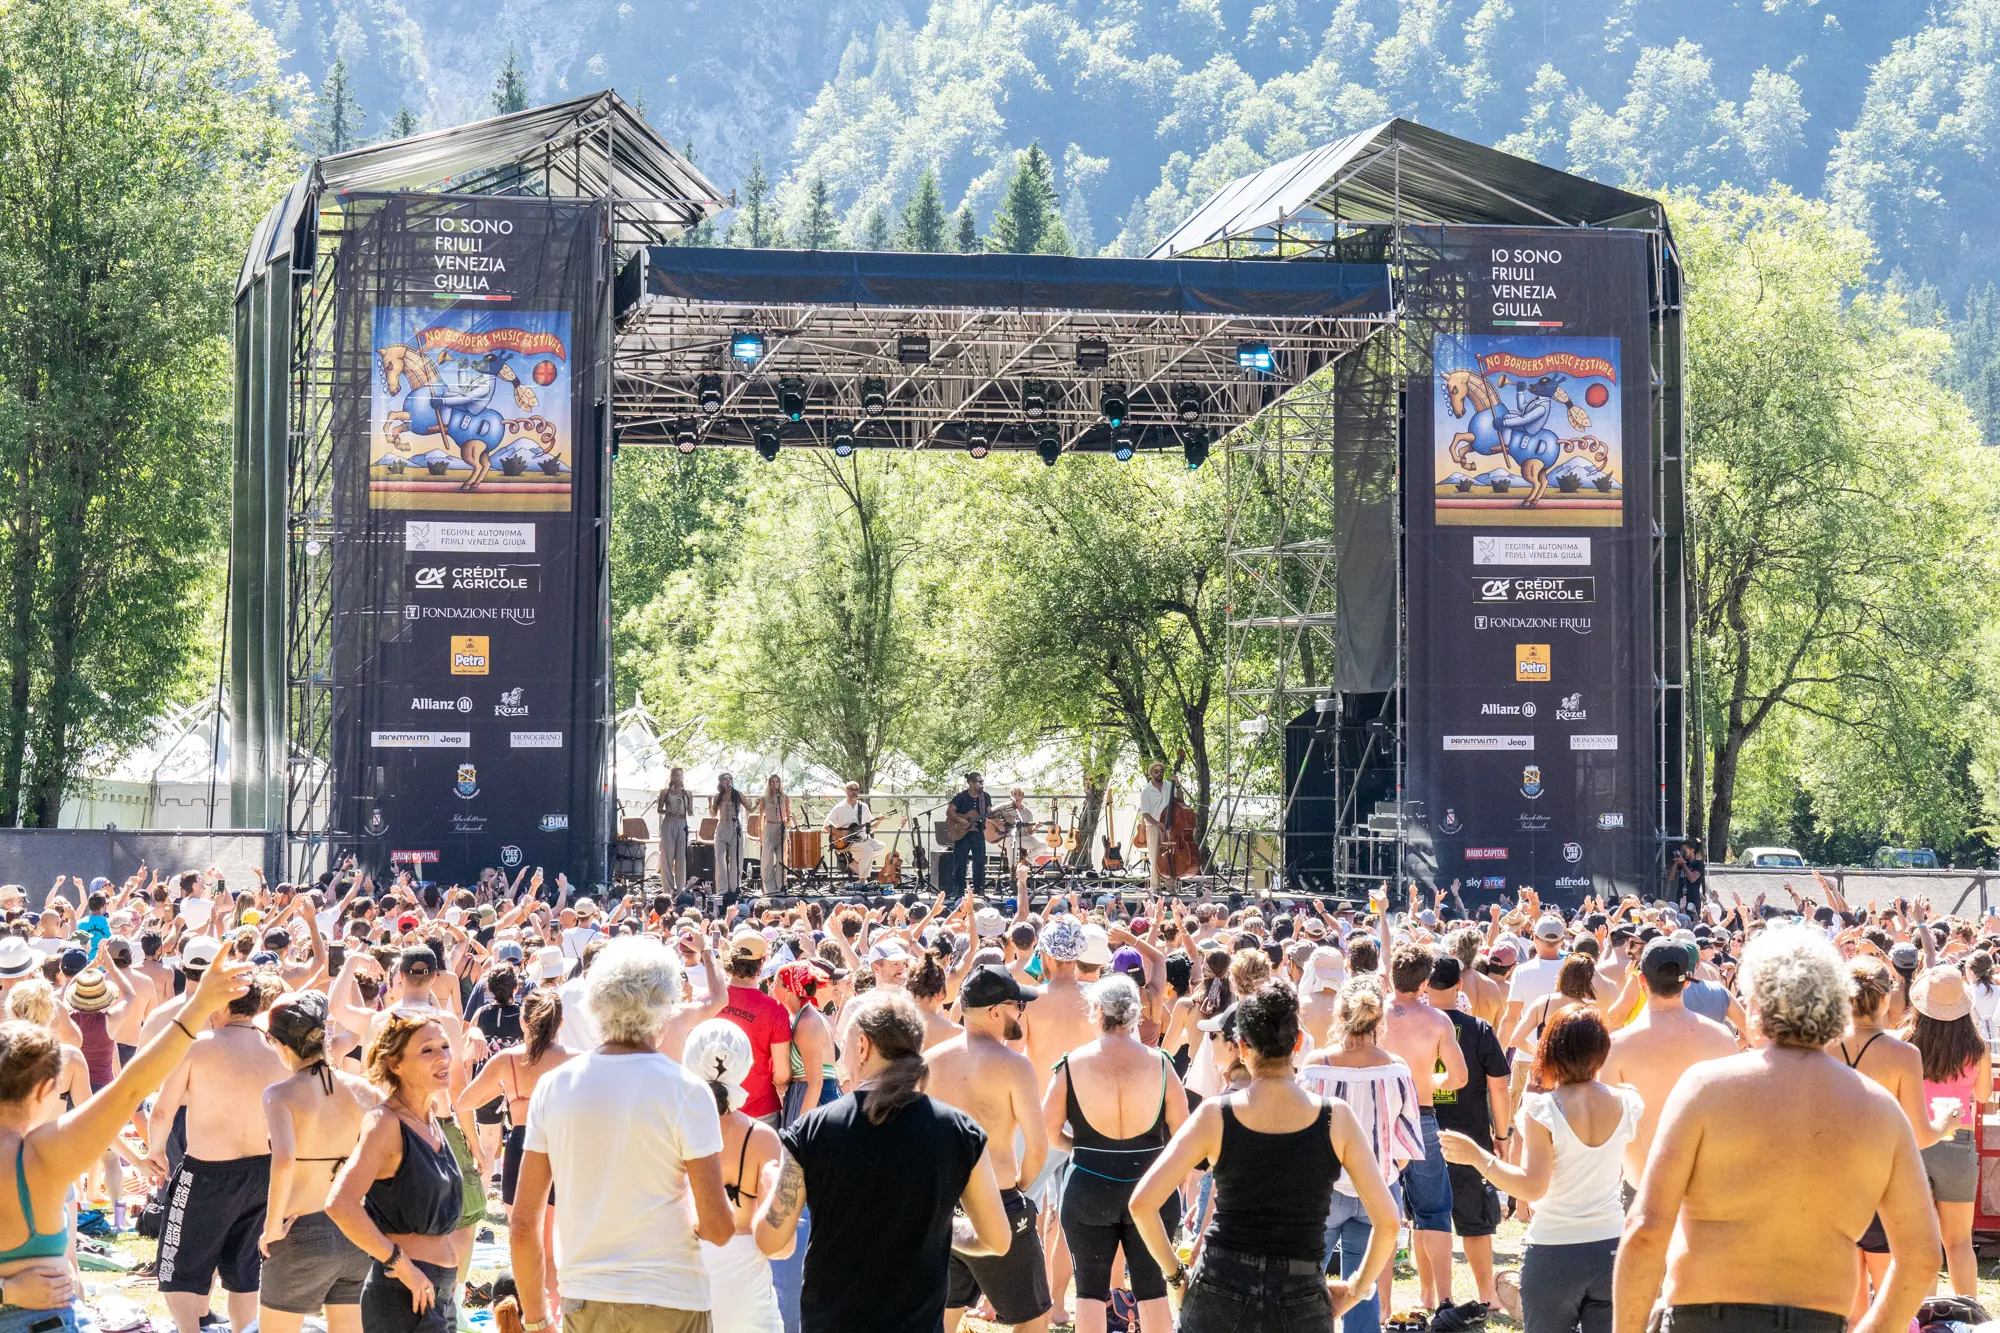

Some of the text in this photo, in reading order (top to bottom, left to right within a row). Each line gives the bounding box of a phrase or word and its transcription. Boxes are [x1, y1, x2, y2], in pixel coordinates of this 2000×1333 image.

[436, 217, 513, 235] IO SONO
[436, 236, 482, 253] FRIULI
[1492, 249, 1562, 264] IO SONO
[434, 255, 506, 272] VENEZIA
[1492, 266, 1534, 281] FRIULI
[435, 274, 490, 290] GIULIA
[1492, 284, 1557, 299] VENEZIA
[1493, 302, 1543, 317] GIULIA
[426, 329, 561, 353] NO BORDERS MUSIC FESTIVAL
[1486, 354, 1613, 377] NO BORDERS MUSIC FESTIVAL
[442, 528, 522, 537] REGIONE AUTONOMA
[441, 537, 526, 546] FRIULI VENEZIA GIULIA
[1505, 551, 1583, 559] FRIULI VENEZIA GIULIA
[452, 565, 507, 578] CRÉDIT
[452, 578, 528, 589] AGRICOLE
[1515, 578, 1565, 590] CRÉDIT
[1516, 590, 1584, 600] AGRICOLE
[423, 607, 536, 624] FONDAZIONE FRIULI
[1490, 617, 1592, 633] FONDAZIONE FRIULI
[455, 653, 486, 667] Petra
[1520, 661, 1547, 673] Petra
[411, 698, 455, 710] Allianz
[1481, 703, 1520, 715] Allianz
[495, 705, 529, 717] Kozel
[1556, 709, 1587, 721] Kozel
[441, 735, 462, 744] Jeep
[1508, 739, 1527, 747] Jeep
[548, 816, 568, 827] BIM
[1605, 815, 1623, 825] BIM
[393, 852, 437, 860] RADIO CAPITAL
[1467, 849, 1507, 857] RADIO CAPITAL
[1466, 877, 1504, 889] sky arte
[1556, 876, 1590, 886] alfredo
[172, 1184, 182, 1208] FASTER
[179, 1186, 190, 1209] FASTER
[164, 1221, 174, 1247] FASTER
[172, 1223, 182, 1247] FASTER
